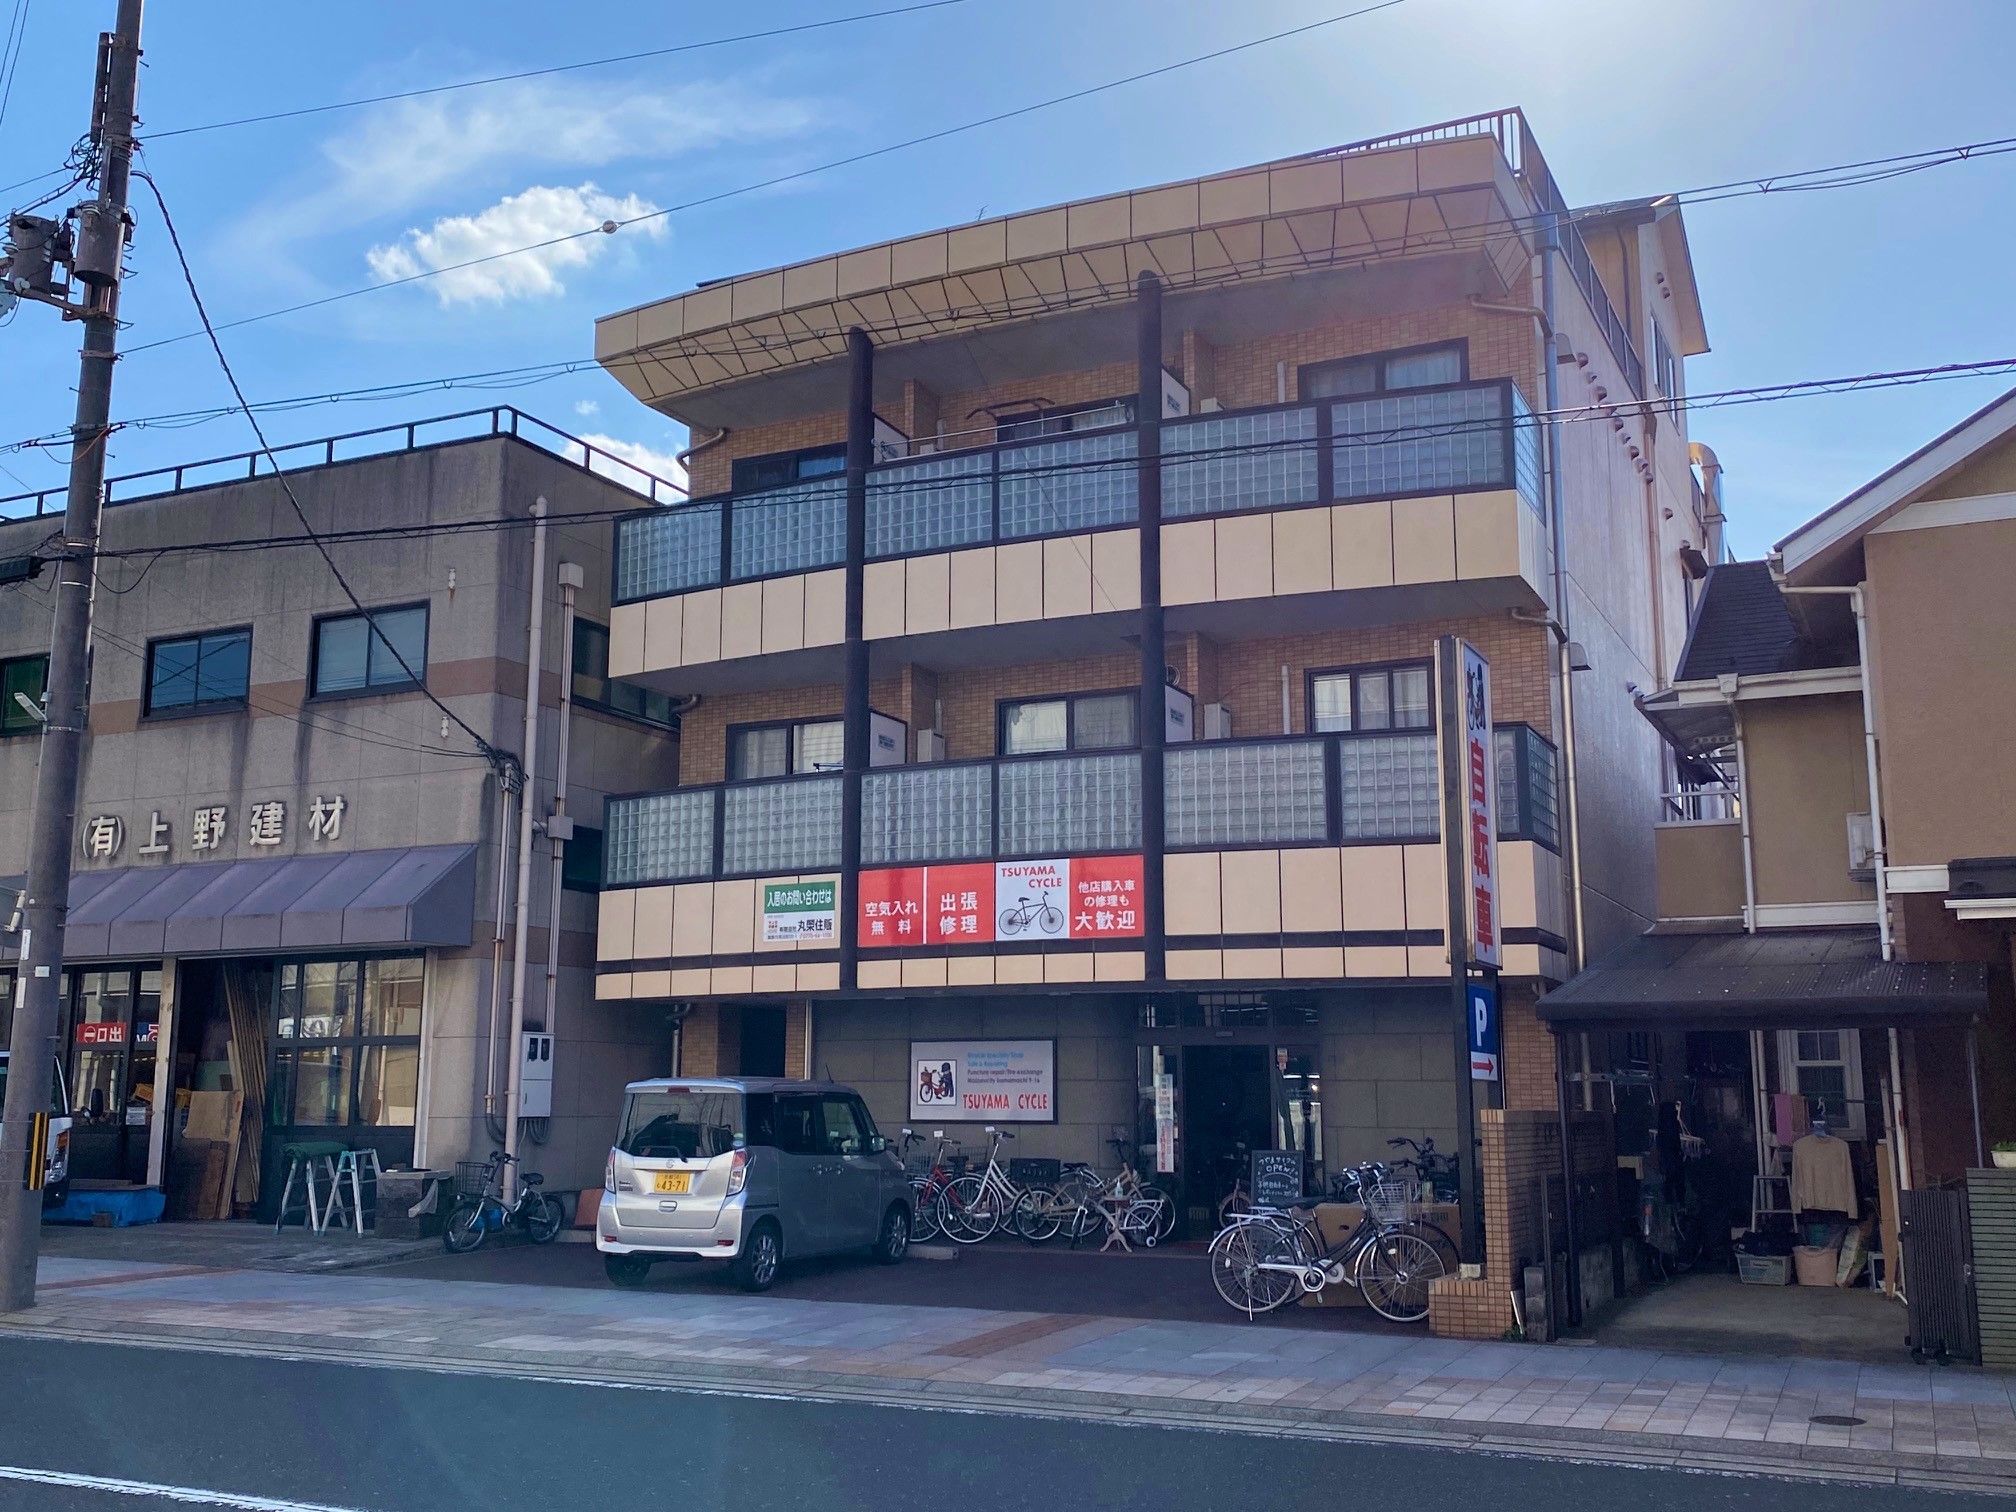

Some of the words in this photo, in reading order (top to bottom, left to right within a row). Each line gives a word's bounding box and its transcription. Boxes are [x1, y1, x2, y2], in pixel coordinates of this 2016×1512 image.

[1469, 737, 1494, 954] 自転車
[1001, 865, 1056, 877] TSUYAMA
[1028, 877, 1062, 889] CYCLE
[1078, 879, 1135, 894] 他店購入車
[767, 889, 832, 907] 入居のお問い合わせは
[940, 891, 978, 912] 出張
[1084, 894, 1129, 908] の修理も
[865, 900, 918, 917] 空気入れ
[871, 918, 912, 935] 無料
[939, 915, 978, 935] 修理
[1074, 909, 1136, 932] 大歓迎
[1474, 996, 1488, 1046] P
[963, 1094, 1009, 1109] TSUYAMA
[1018, 1094, 1048, 1109] CYCLE
[662, 1180, 686, 1192] 43-71
